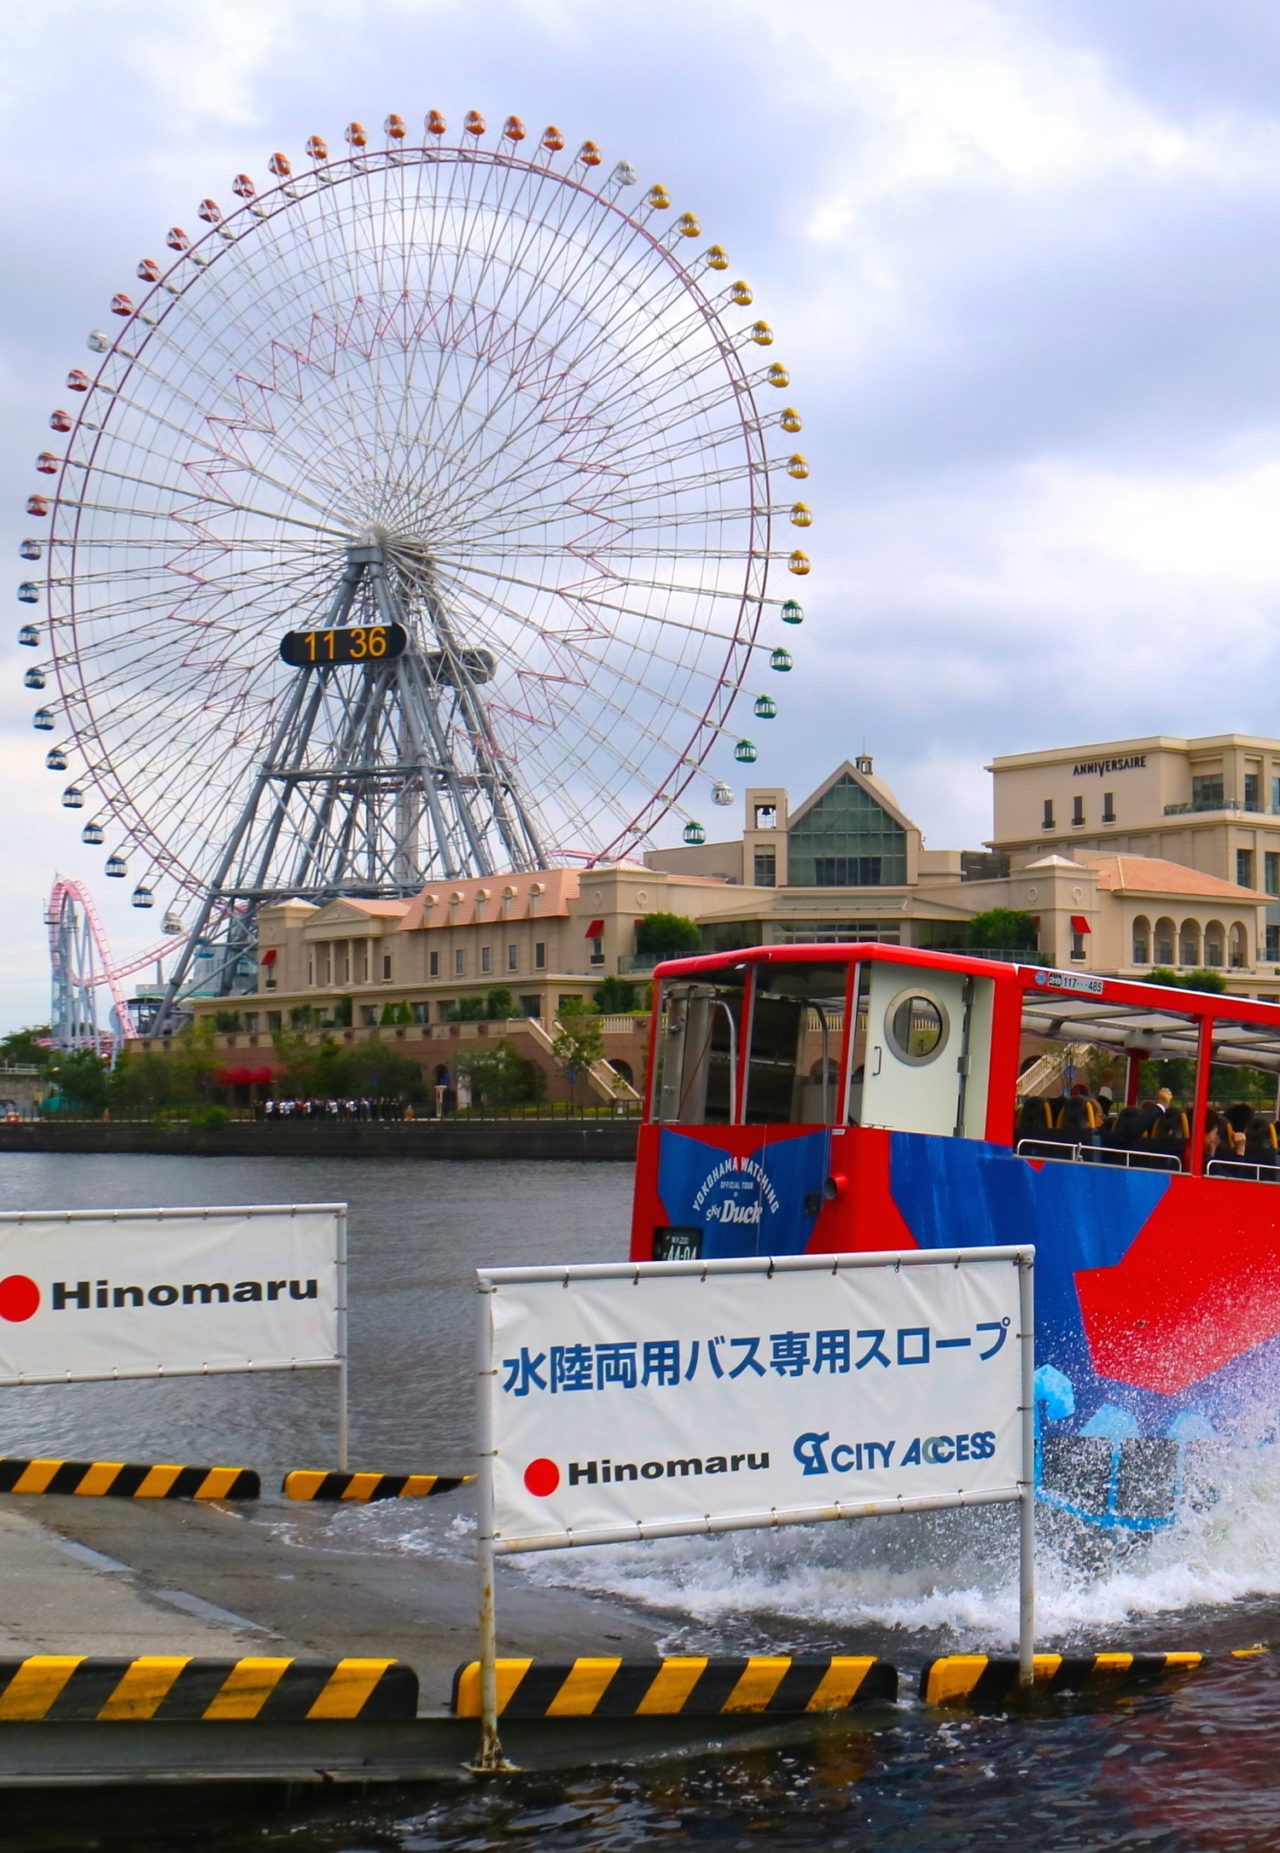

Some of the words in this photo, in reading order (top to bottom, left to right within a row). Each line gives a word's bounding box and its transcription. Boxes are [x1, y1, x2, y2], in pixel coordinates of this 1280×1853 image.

[304, 631, 336, 661] 11
[349, 626, 387, 659] 36
[1072, 755, 1147, 777] ANNIVERSAIRE
[692, 1156, 738, 1212] YOKOHAMA
[741, 1156, 780, 1214] WATCHING
[720, 1199, 763, 1224] Duck
[52, 1278, 319, 1311] Hinomaru
[501, 1316, 1012, 1397] 水陸両用バス専用スロープ
[568, 1450, 770, 1487] Hinomaru
[831, 1440, 896, 1473] CITY
[900, 1430, 997, 1467] ACCESS
